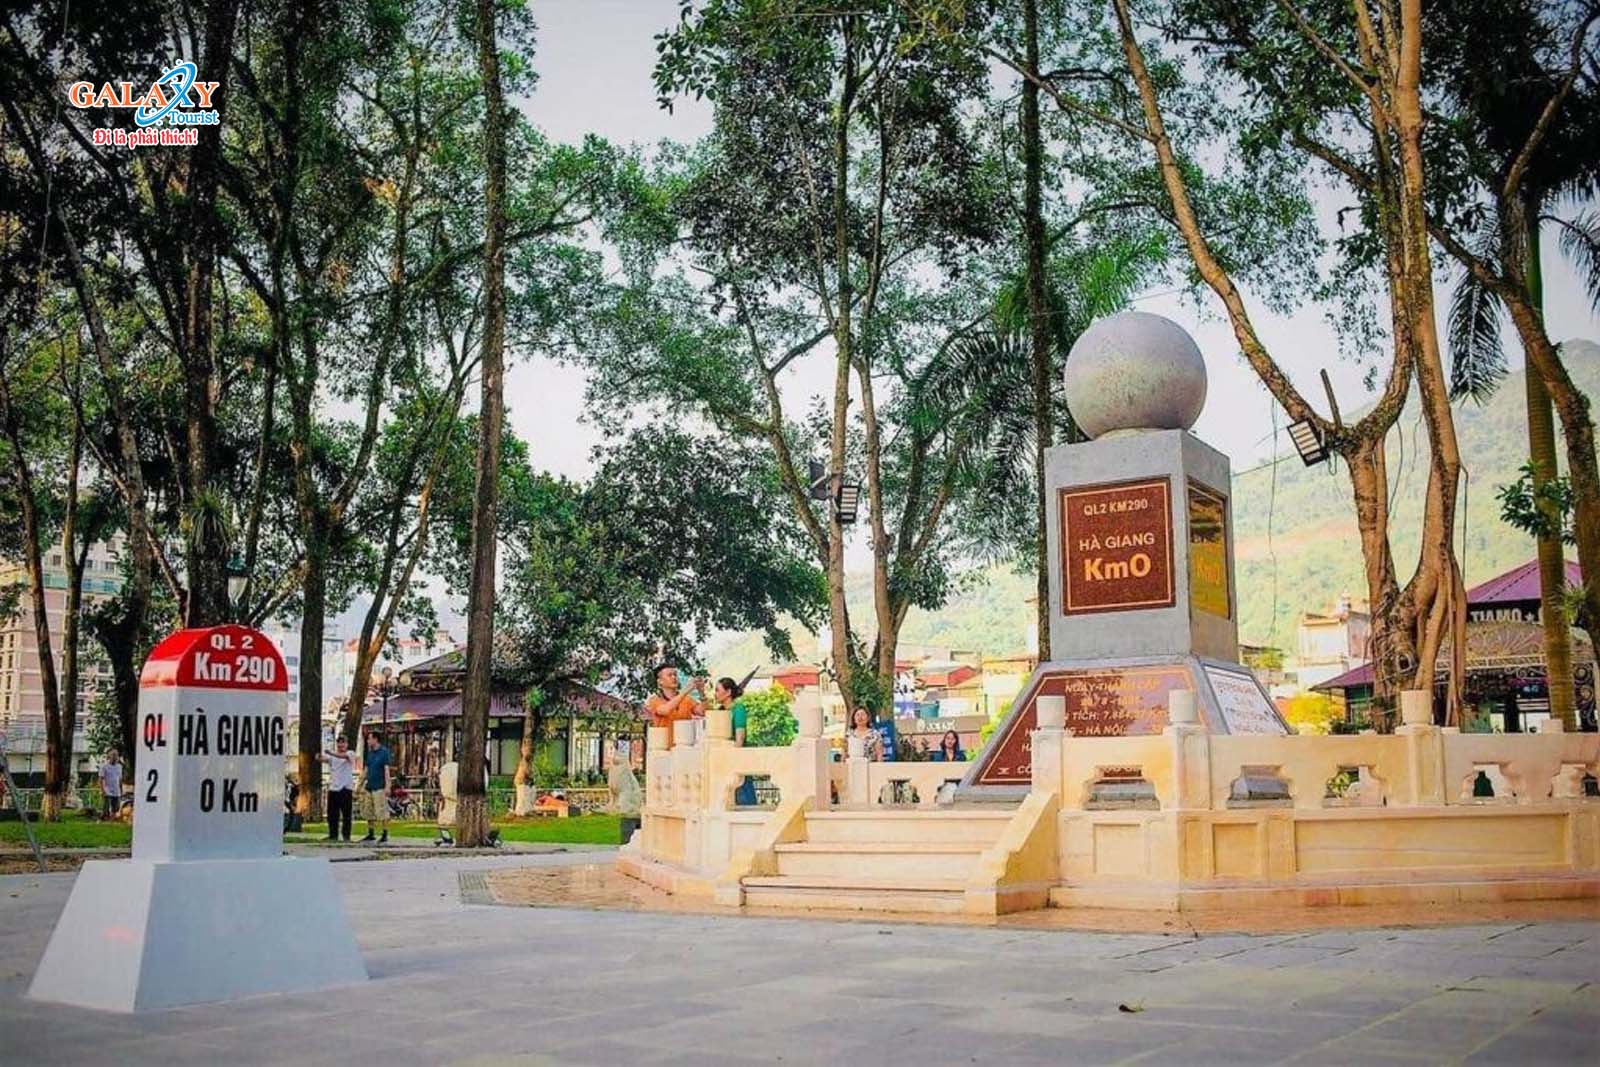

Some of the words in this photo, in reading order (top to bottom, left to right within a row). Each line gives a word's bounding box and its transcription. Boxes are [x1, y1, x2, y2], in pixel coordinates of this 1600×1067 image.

[1083, 503, 1107, 516] QL2
[1079, 534, 1101, 551] HÀ
[1105, 532, 1155, 549] GIANG
[1470, 608, 1522, 623] TIAMO
[210, 634, 235, 650] QL
[241, 635, 254, 649] 2
[194, 652, 231, 681] Km
[235, 655, 276, 684] 290
[144, 714, 165, 750] QL
[178, 707, 208, 755] HÀ
[217, 714, 283, 755] GIANG
[146, 768, 158, 802] 2
[200, 778, 214, 812] 0
[222, 778, 258, 813] Km
